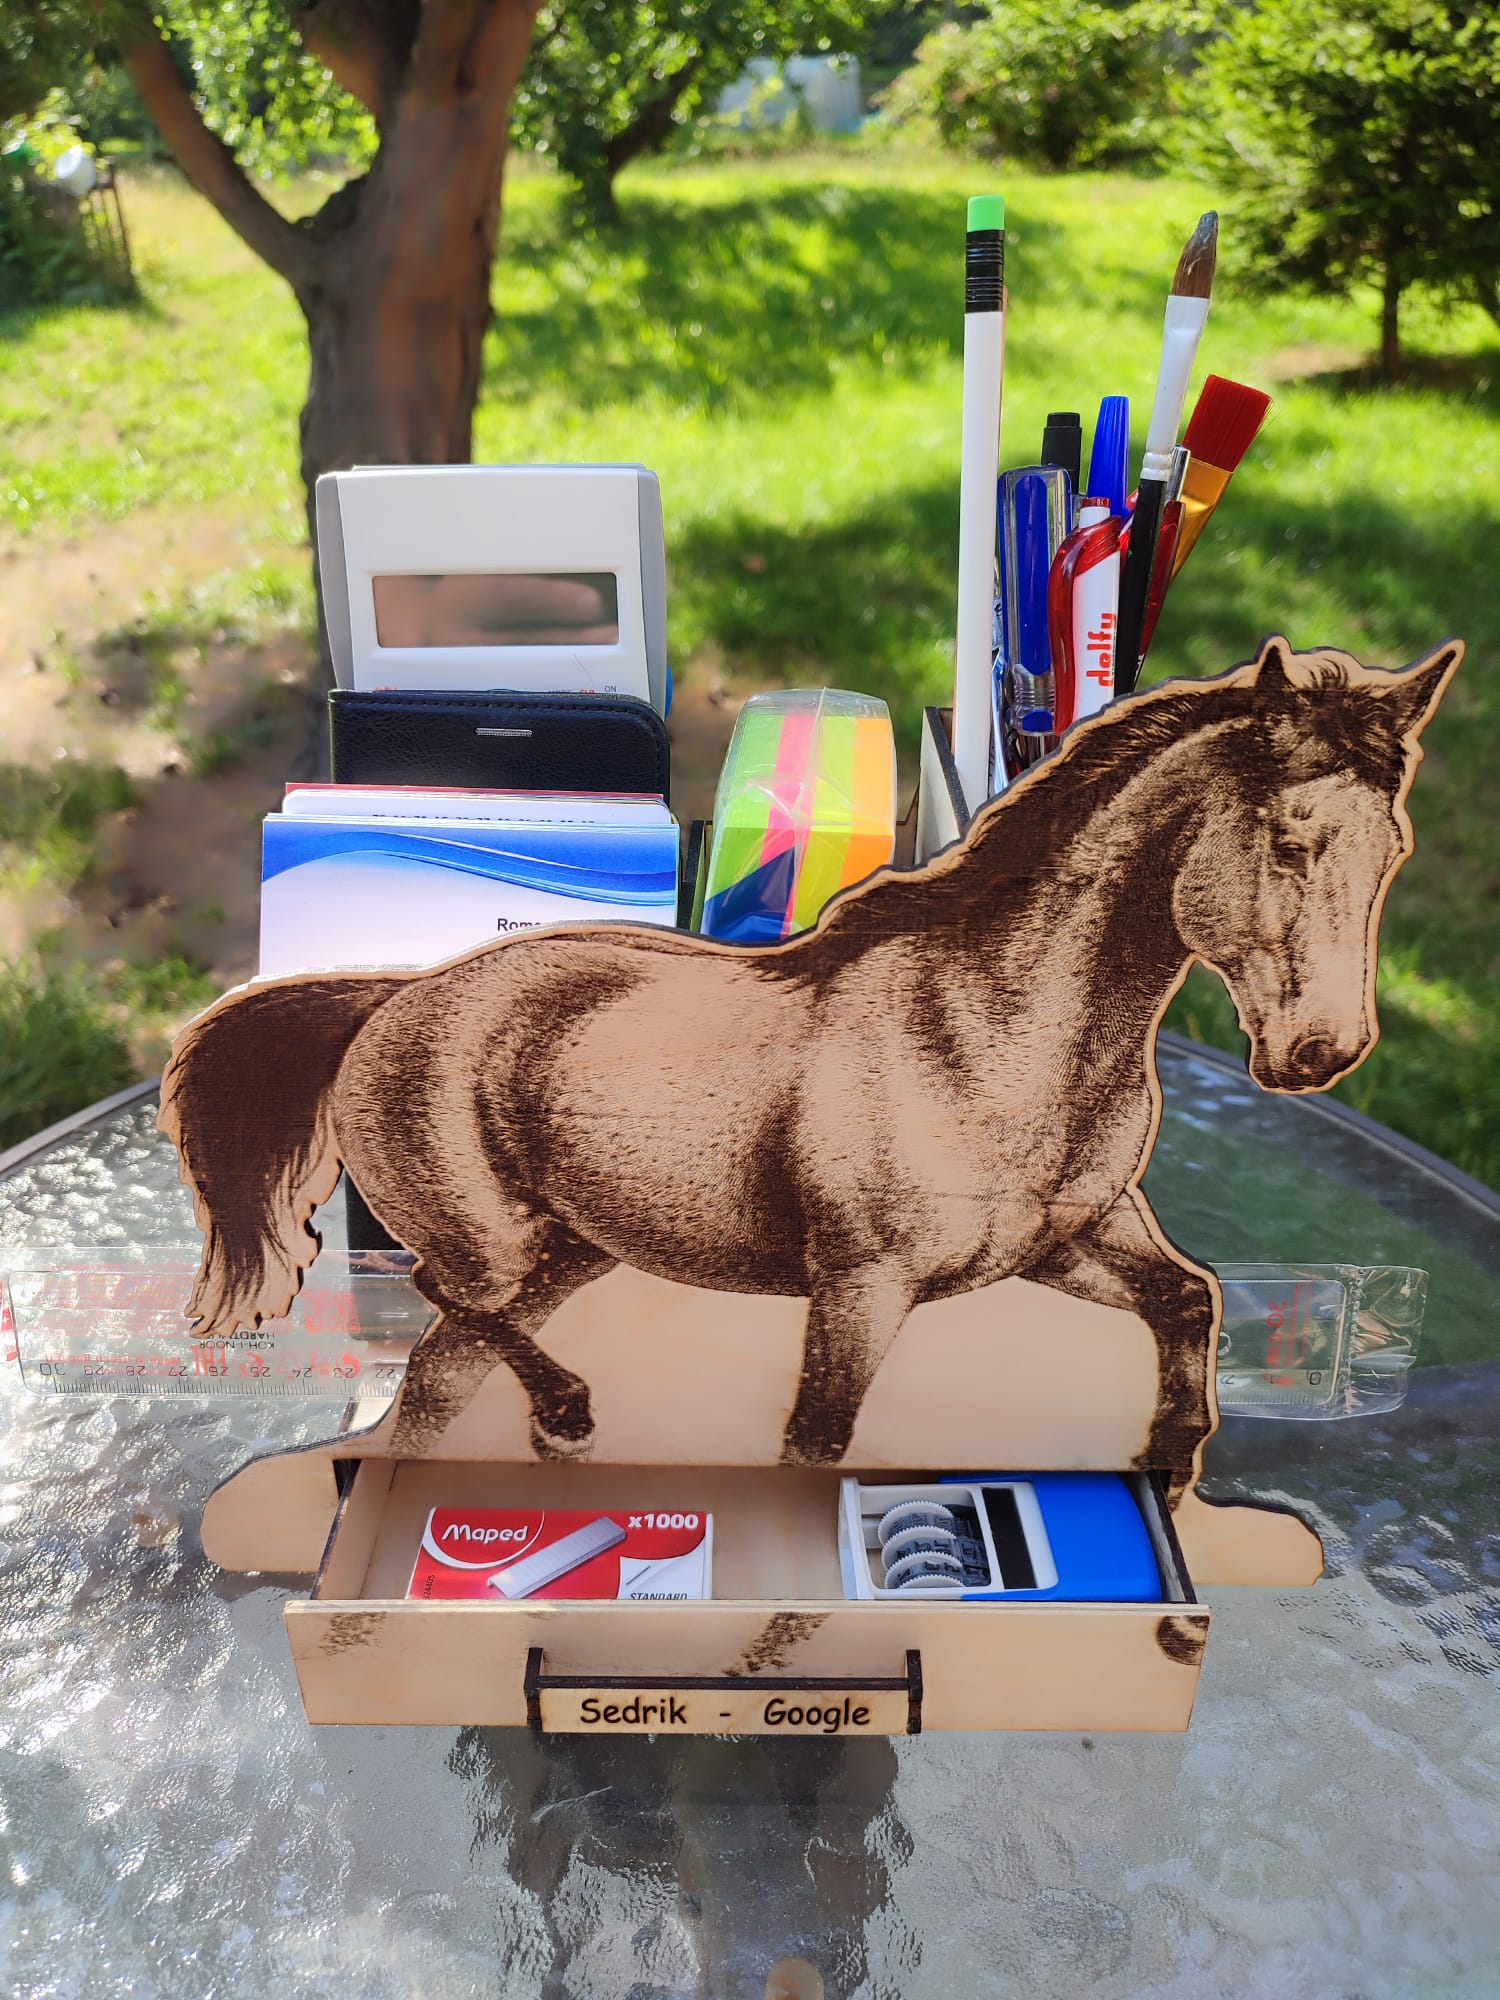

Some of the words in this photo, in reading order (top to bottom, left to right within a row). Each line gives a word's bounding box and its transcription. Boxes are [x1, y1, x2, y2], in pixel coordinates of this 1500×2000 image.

[1086, 613, 1117, 687] delfy
[604, 685, 617, 693] ON
[199, 1341, 275, 1350] KOH-I-NOOR
[39, 1362, 66, 1376] 30
[126, 1365, 146, 1377] 28
[167, 1365, 188, 1377] 27
[208, 1366, 229, 1377] 26
[250, 1366, 271, 1377] 25
[292, 1366, 313, 1378] 24
[375, 1367, 395, 1379] 22
[628, 1513, 699, 1529] x1000
[442, 1523, 528, 1544] Maped
[580, 1697, 687, 1725] Sedrik
[763, 1698, 870, 1733] Google
